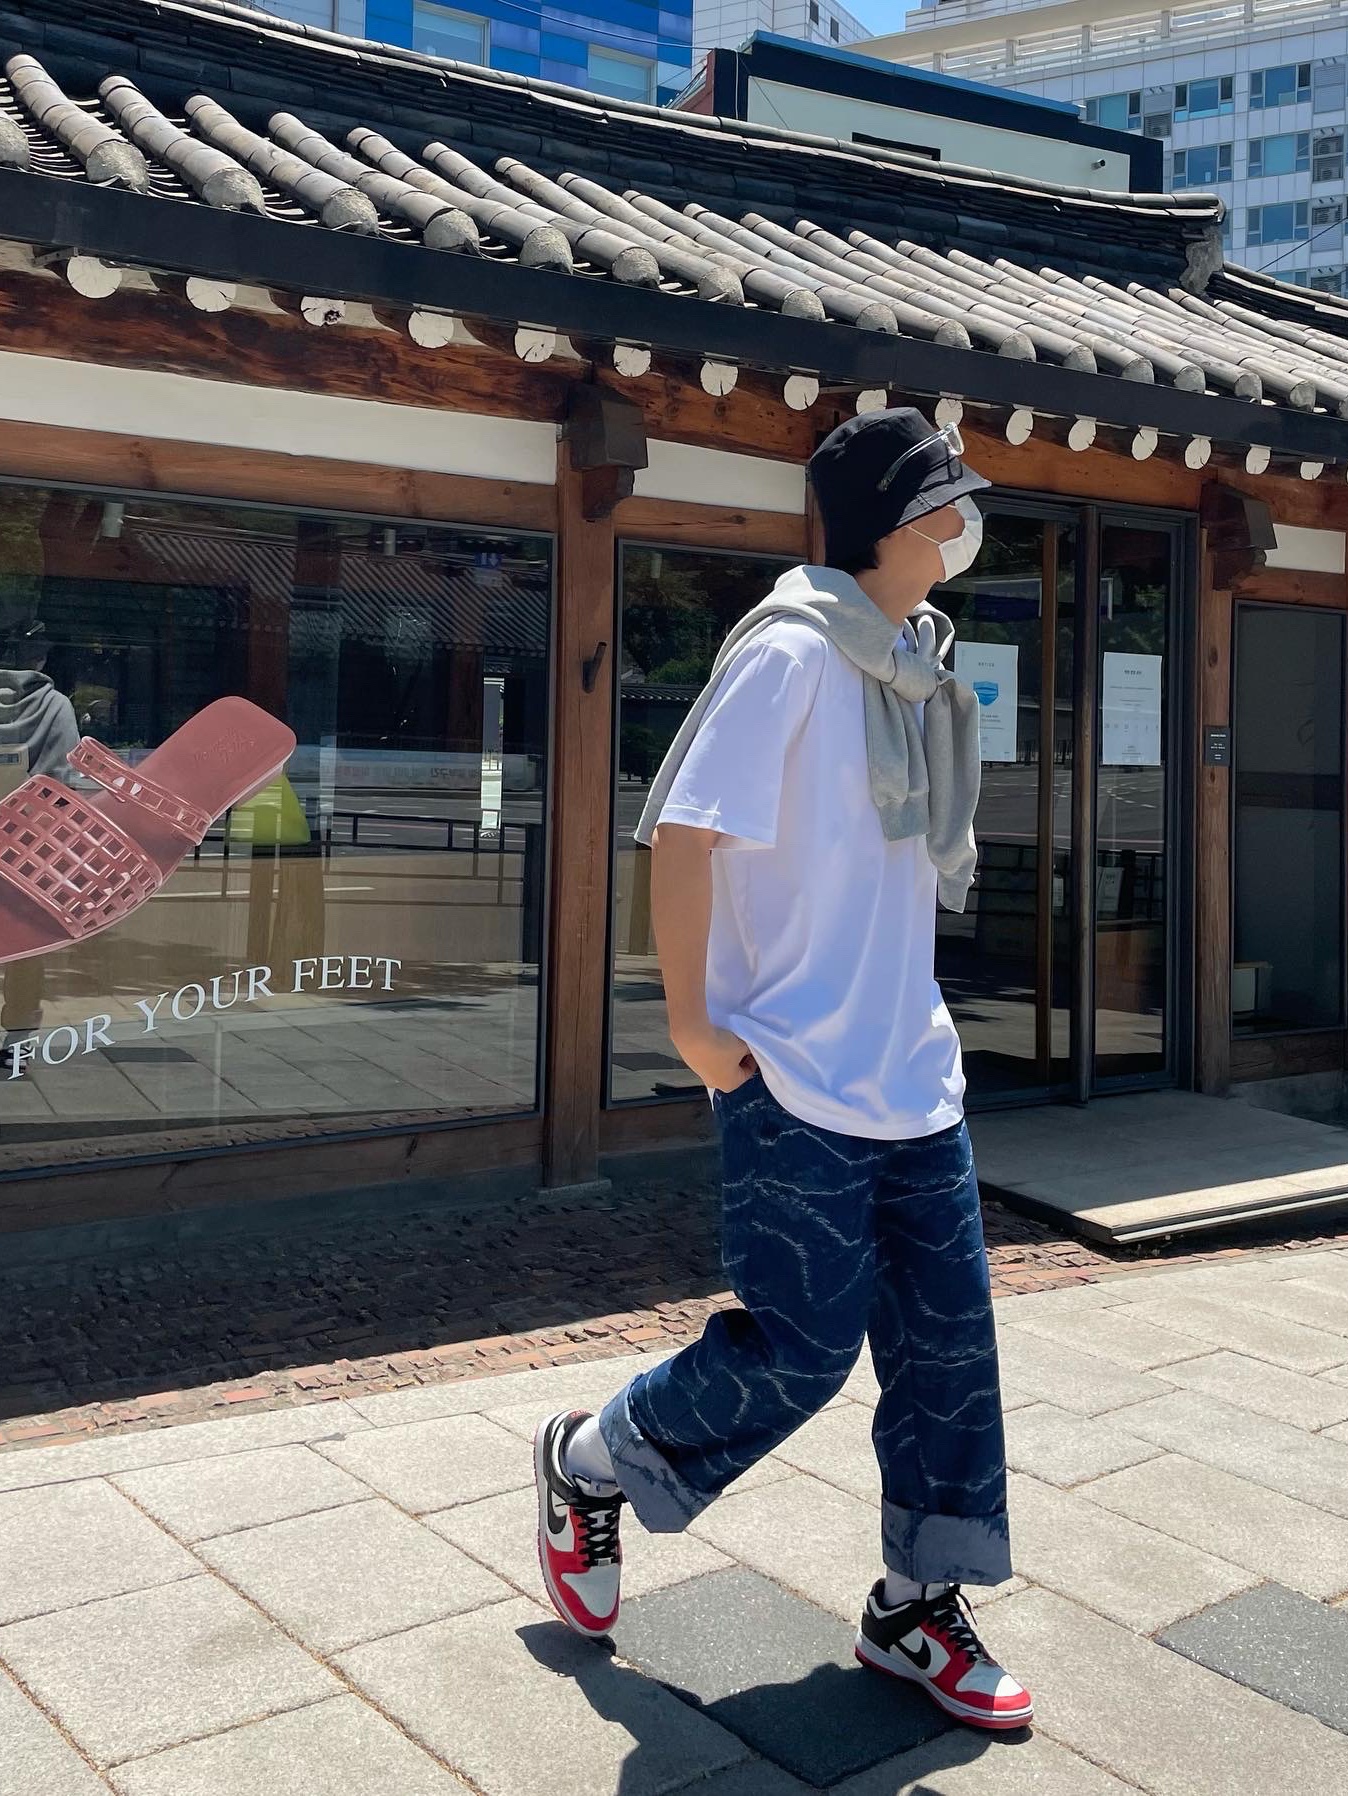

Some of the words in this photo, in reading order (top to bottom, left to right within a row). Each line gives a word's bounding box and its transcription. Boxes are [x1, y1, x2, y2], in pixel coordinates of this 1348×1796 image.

[7, 1013, 116, 1081] FOR
[134, 965, 275, 1034] YOUR
[290, 955, 402, 993] FEET
